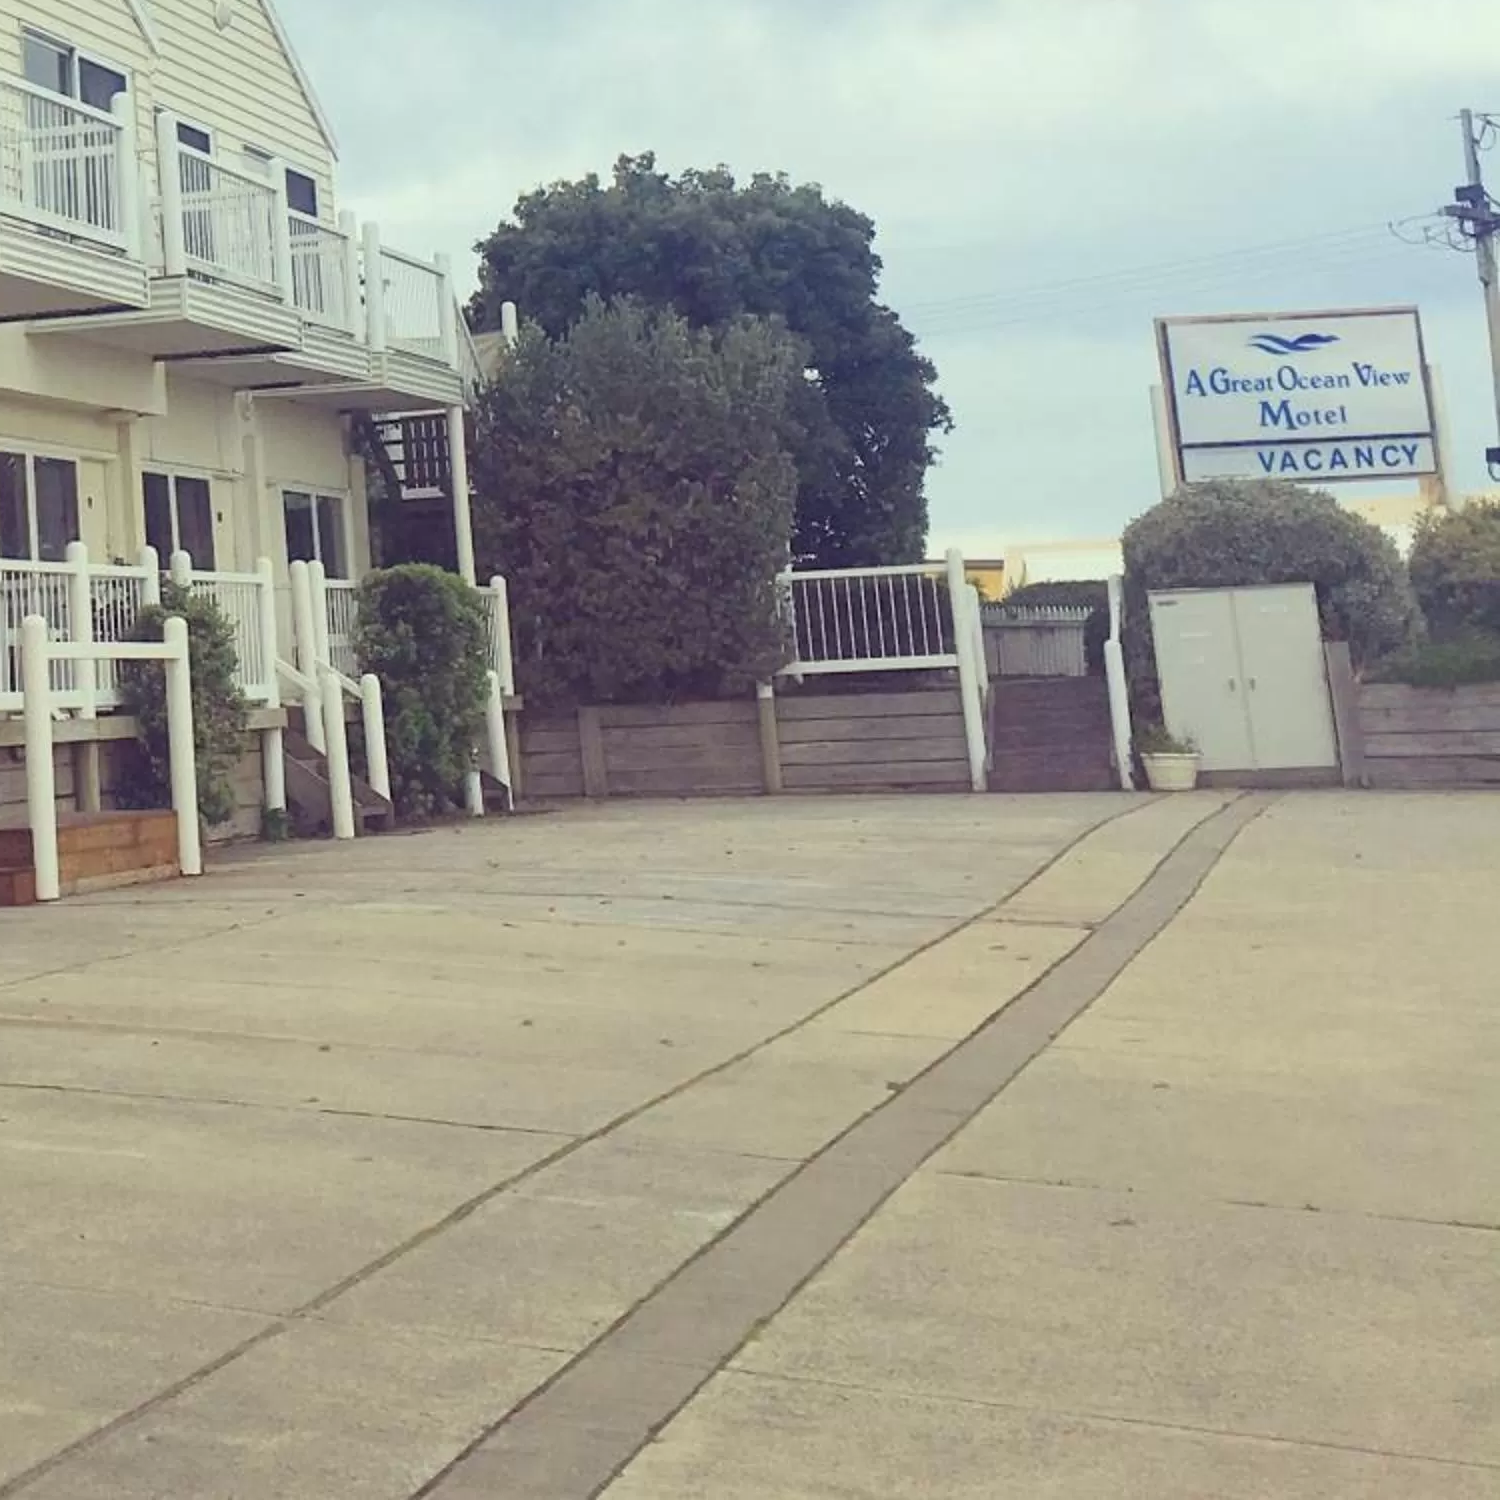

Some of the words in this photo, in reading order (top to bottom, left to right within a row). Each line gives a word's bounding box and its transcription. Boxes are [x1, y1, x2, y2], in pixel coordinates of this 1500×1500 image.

[1185, 369, 1207, 397] A
[1209, 367, 1274, 395] Great
[1277, 365, 1350, 390] Ocean
[1351, 361, 1411, 387] View
[1259, 399, 1348, 430] Motel
[1257, 444, 1418, 473] VACANCY
